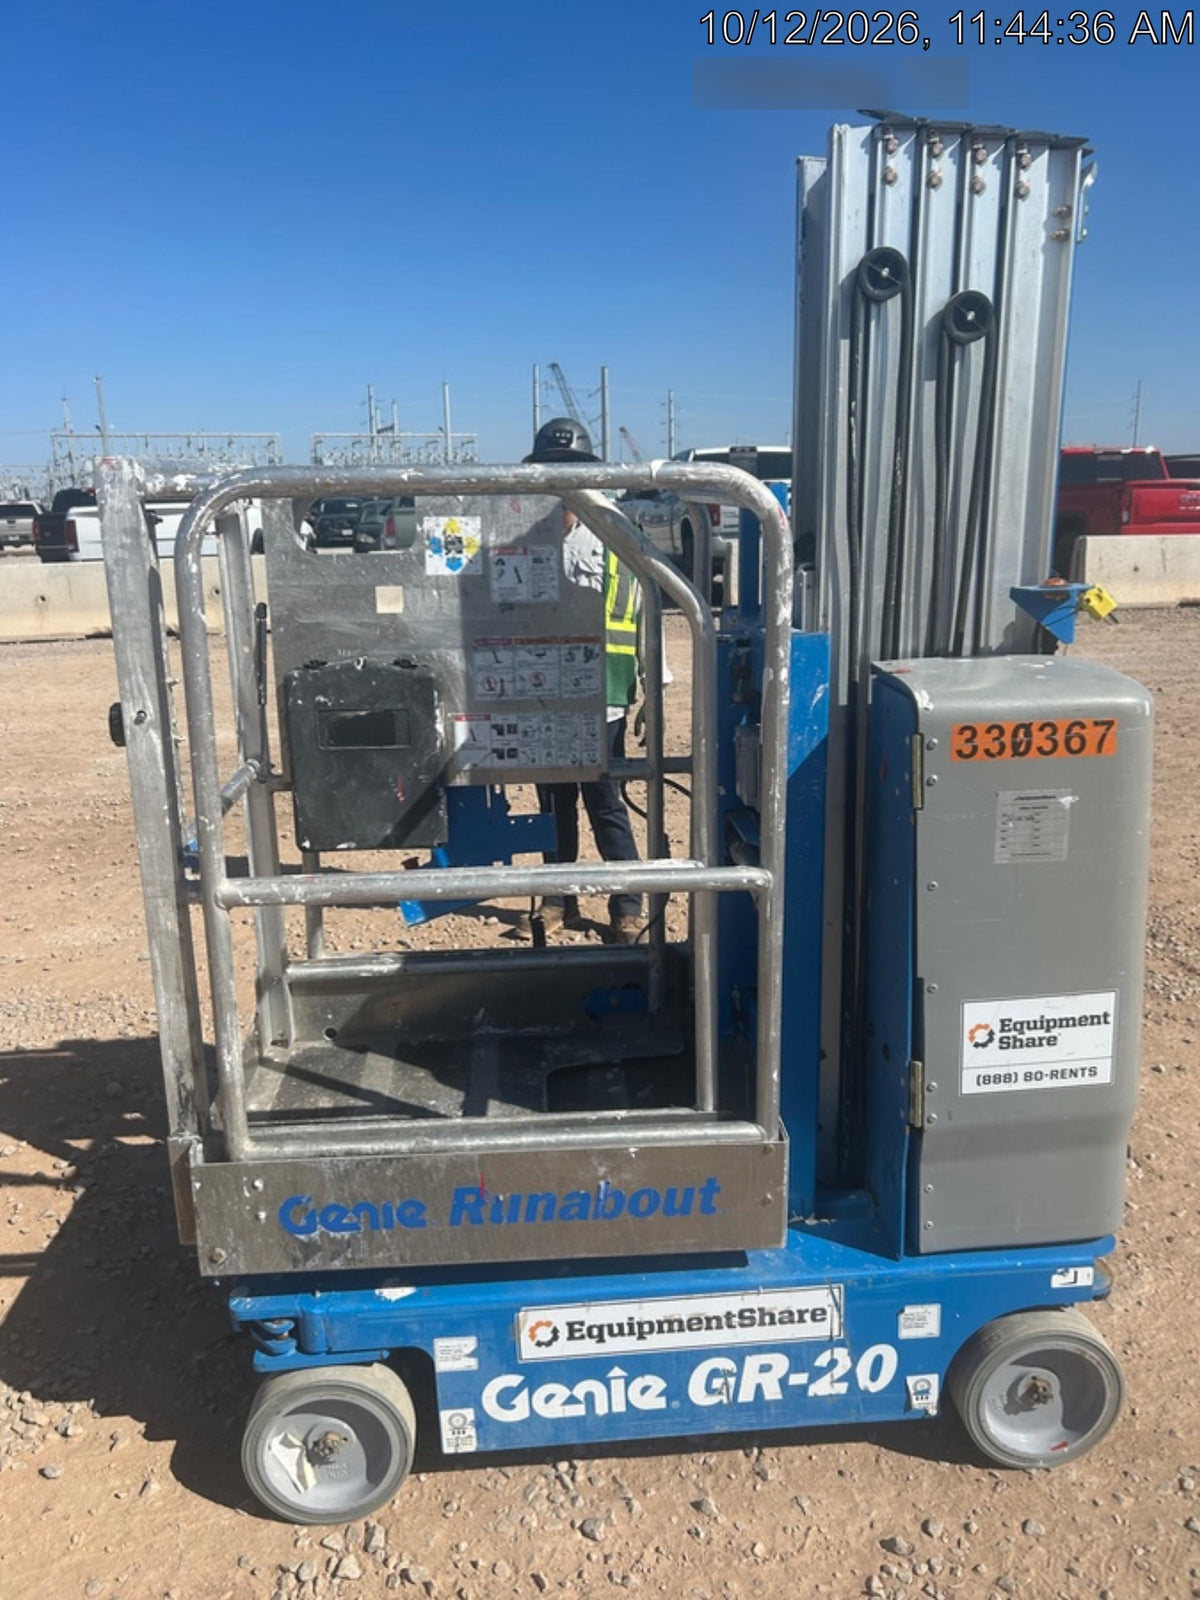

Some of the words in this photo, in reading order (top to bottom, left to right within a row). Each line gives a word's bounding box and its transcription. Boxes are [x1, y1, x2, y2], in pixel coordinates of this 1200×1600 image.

[999, 1011, 1110, 1035] Equipment
[998, 1034, 1058, 1051] Share
[976, 1072, 1018, 1087] (888)
[1023, 1066, 1098, 1082] 80-RENTS
[278, 1194, 427, 1236] Genie
[449, 1177, 720, 1226] Runabout
[565, 1304, 828, 1342] EquipmentShare
[481, 1365, 668, 1423] Genie
[688, 1343, 898, 1407] GR-20
